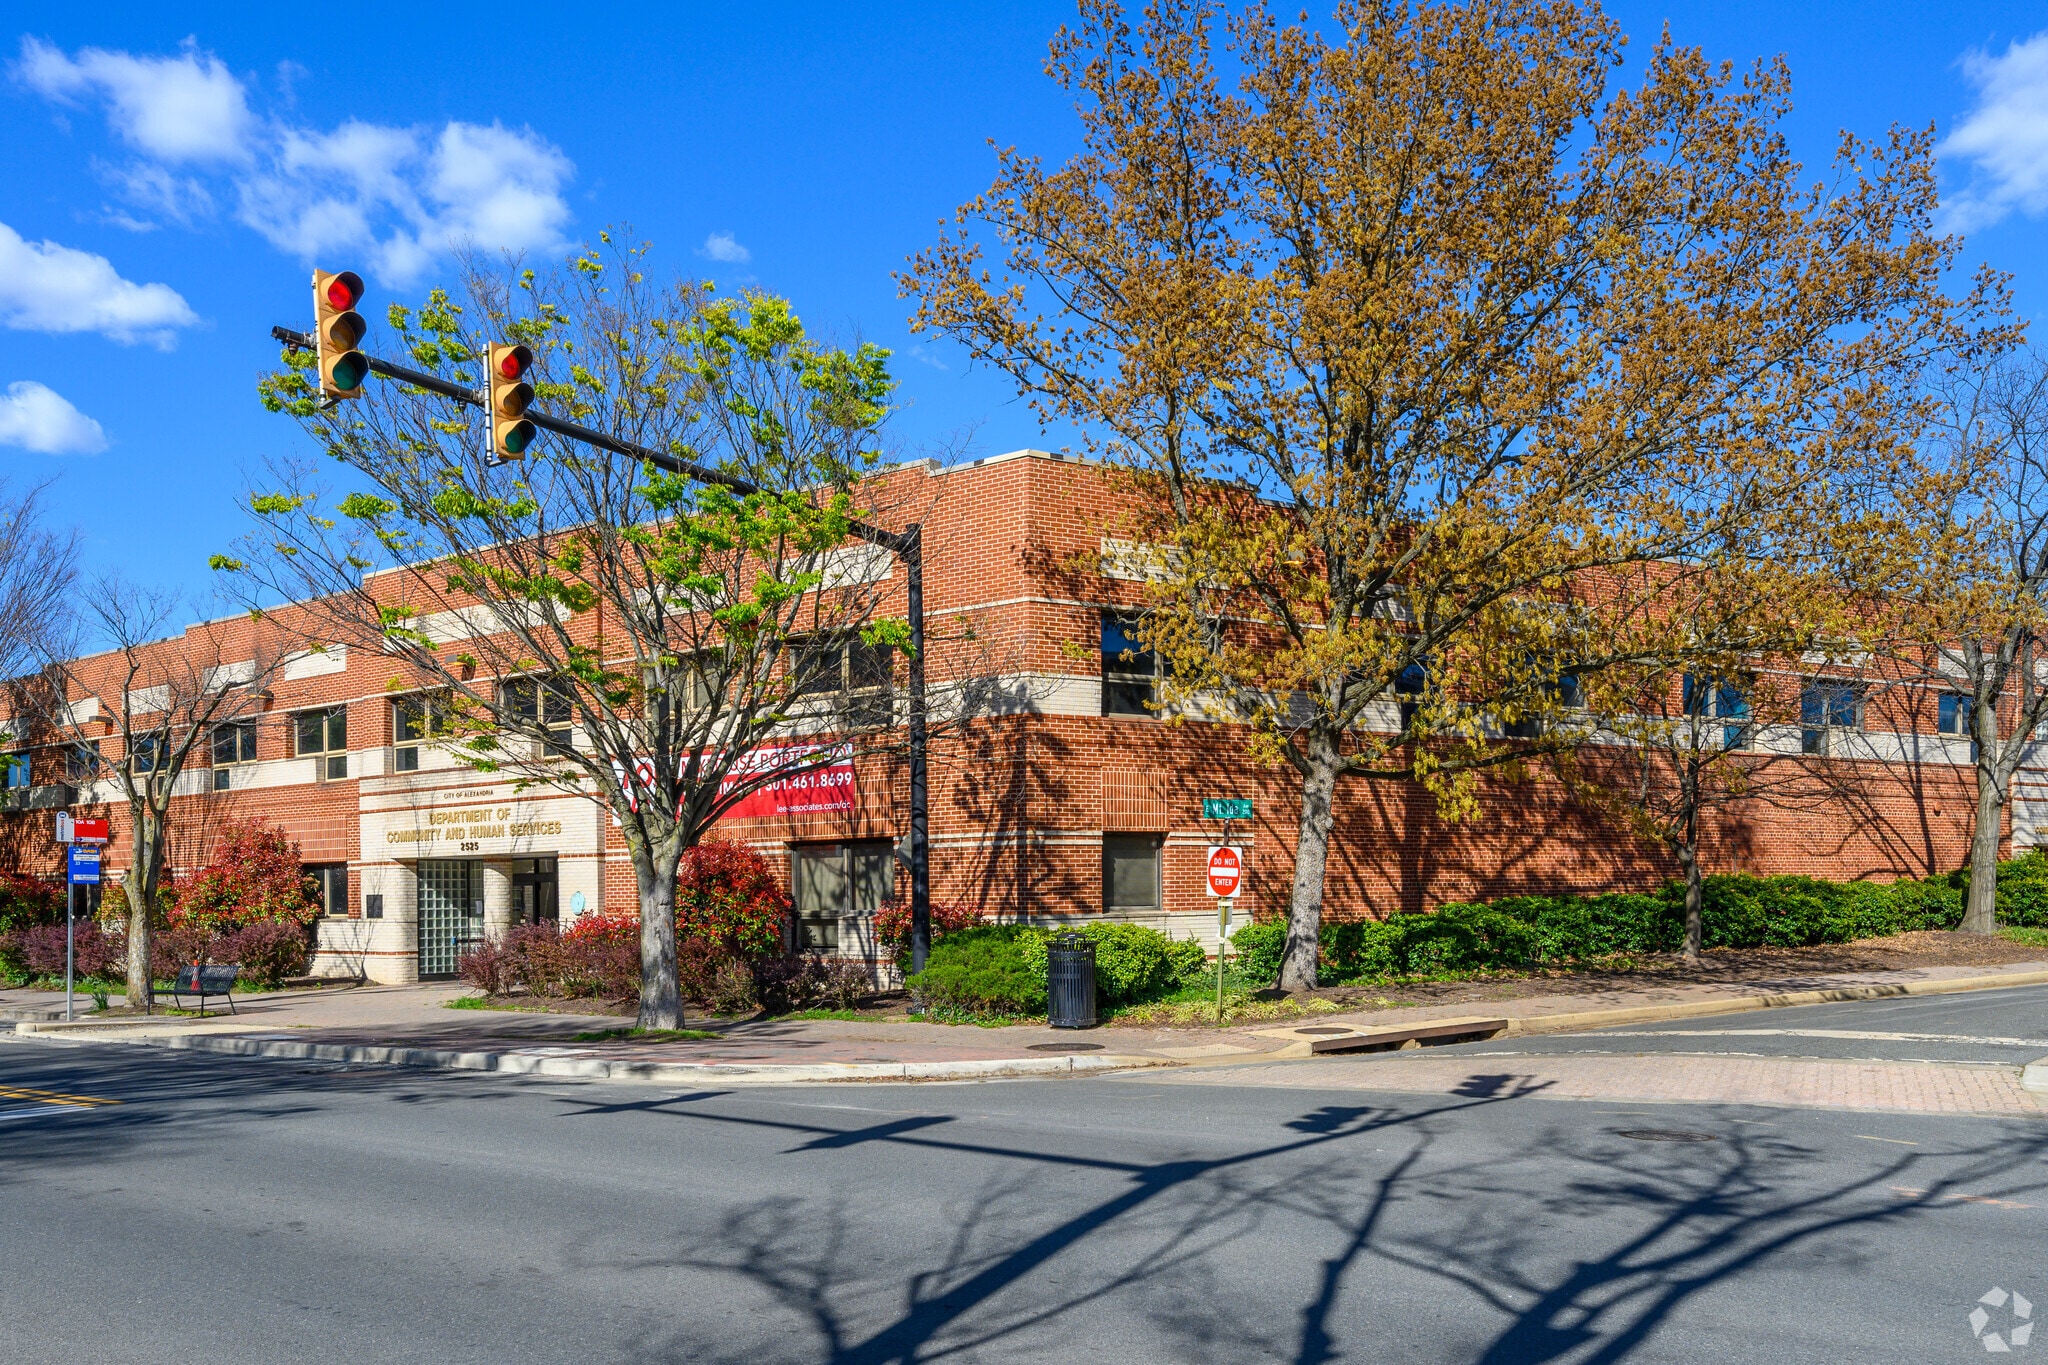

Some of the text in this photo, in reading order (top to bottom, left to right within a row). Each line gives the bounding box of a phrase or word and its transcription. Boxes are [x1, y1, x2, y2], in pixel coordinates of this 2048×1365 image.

[765, 772, 852, 792] 301.461.8699
[443, 789, 494, 800] CITY OF ALEXANDRIA
[776, 800, 851, 813] lee-associates.com/dc
[1226, 803, 1239, 815] Ida
[428, 807, 512, 826] DEPARTMENT OF
[386, 820, 562, 844] COMMUNITY AND HUMAN SERVICES
[460, 841, 480, 851] 2525
[1213, 857, 1236, 866] DO NOT
[1214, 878, 1233, 887] ENTER
